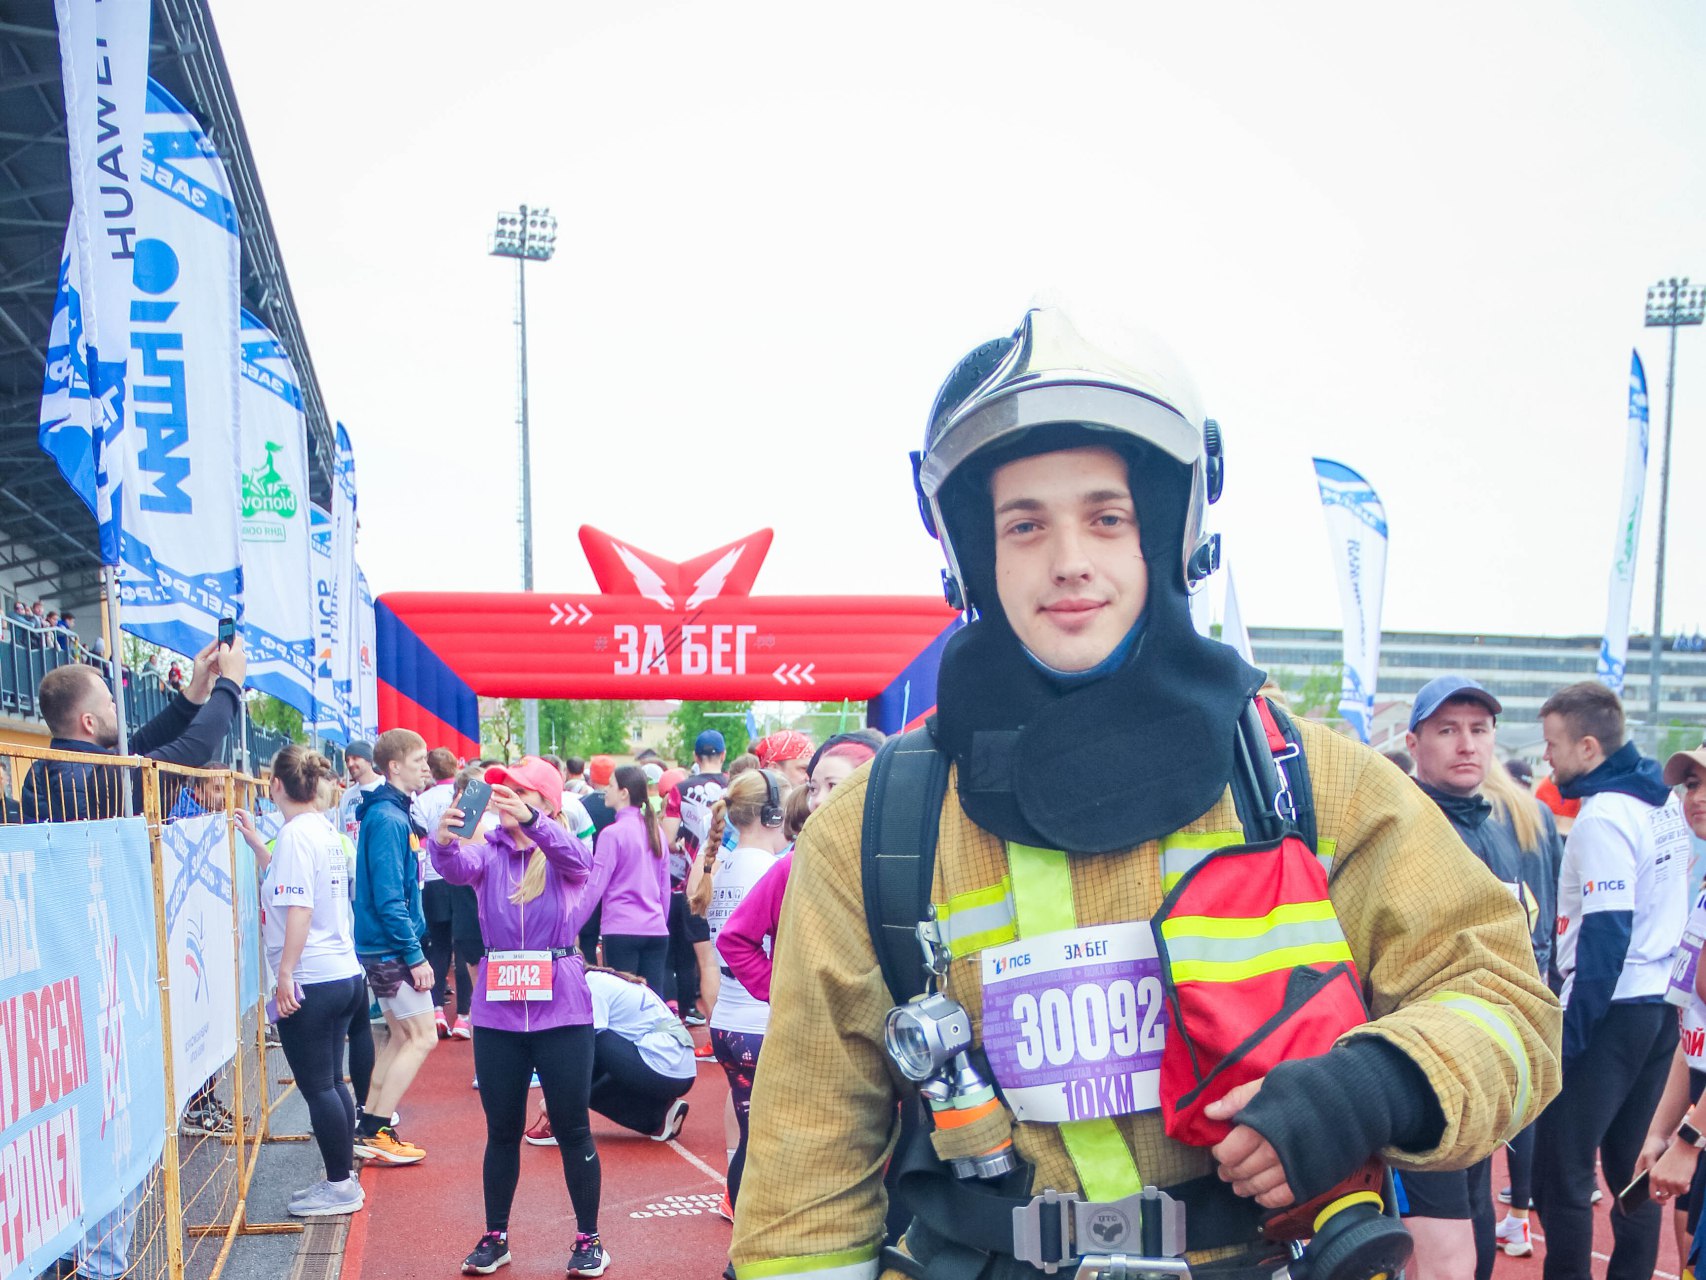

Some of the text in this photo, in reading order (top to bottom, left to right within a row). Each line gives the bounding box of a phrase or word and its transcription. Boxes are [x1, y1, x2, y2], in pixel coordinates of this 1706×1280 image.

[286, 886, 304, 895] ПСБ
[1597, 880, 1626, 892] ПСБ
[1009, 953, 1032, 969] ПСБ
[497, 964, 541, 986] 20142
[1012, 976, 1166, 1070] 30092
[23, 975, 88, 1113] ВСЕМ
